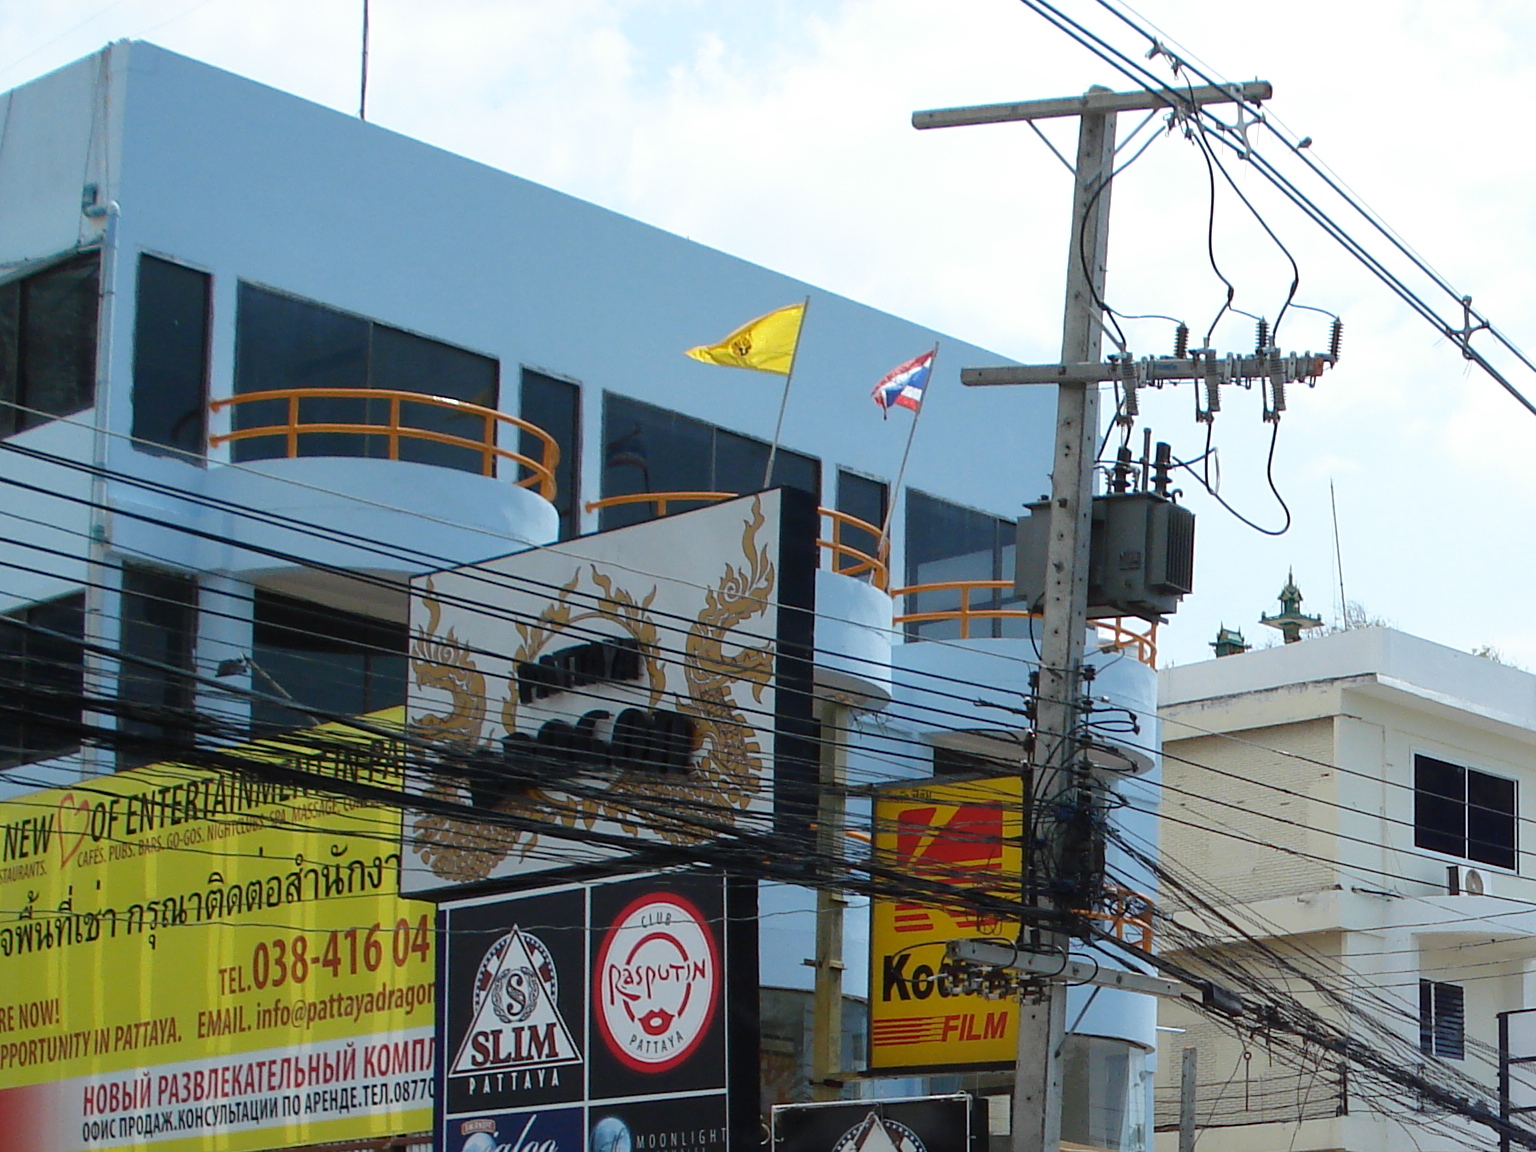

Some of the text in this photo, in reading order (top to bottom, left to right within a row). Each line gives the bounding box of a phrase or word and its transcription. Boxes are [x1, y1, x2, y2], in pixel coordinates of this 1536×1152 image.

[3, 813, 55, 863] NEW
[91, 799, 120, 843] OF
[109, 840, 136, 862] PUBS.
[640, 911, 673, 928] CLUB
[392, 914, 431, 968] 04
[19, 998, 60, 1030] NOW!
[941, 1011, 1009, 1043] FILM
[94, 1027, 110, 1056] IN
[114, 1016, 183, 1053] PATTAYA.
[197, 1005, 252, 1039] EMAIL.
[471, 1022, 560, 1068] SLIM
[628, 1030, 684, 1055] PATTAYA
[83, 1071, 152, 1117] НОВЫЙ
[157, 1042, 357, 1107] РАЗВЛЕКАТЕЛЬНЫЙ
[468, 1070, 560, 1096] PATTAYA
[82, 1117, 116, 1143] ОФИС
[282, 1094, 300, 1117] ПО
[636, 1127, 727, 1150] MOONLIGHT
